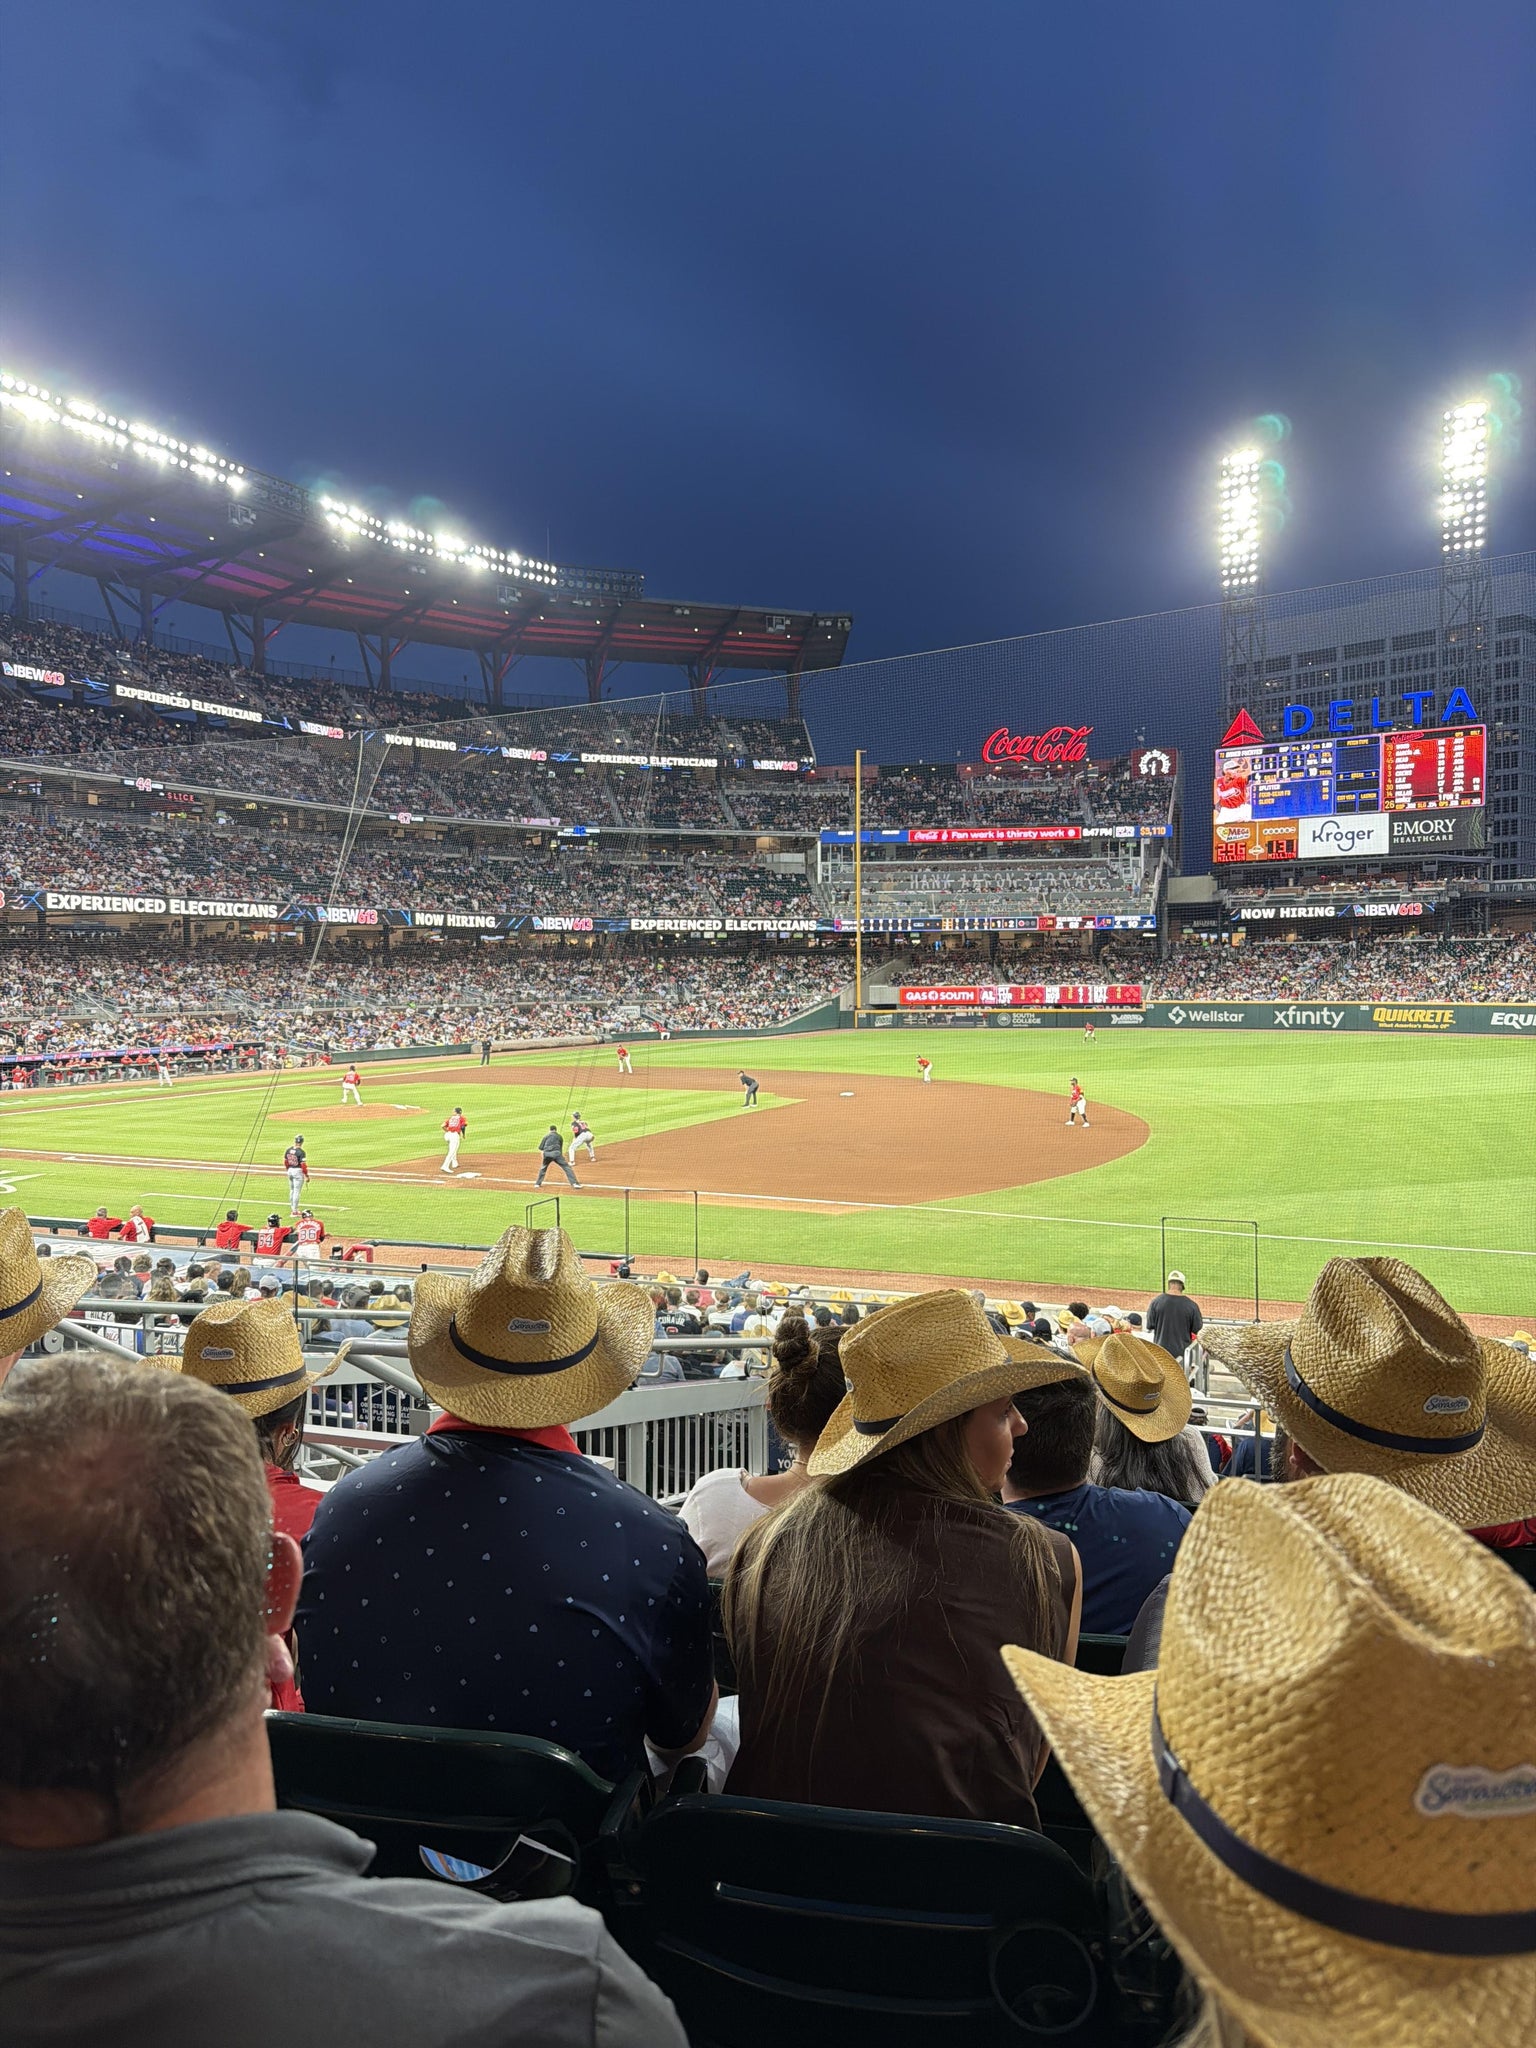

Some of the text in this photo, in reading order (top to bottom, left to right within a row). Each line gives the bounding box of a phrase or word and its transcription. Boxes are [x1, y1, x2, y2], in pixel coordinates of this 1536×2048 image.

[116, 685, 262, 722] EXPERIENCED ELECTRICIANS
[1283, 687, 1478, 737] DELTA
[386, 734, 456, 751] NOW HIRING
[982, 725, 1094, 764] Coca-Cola
[581, 753, 718, 768] EXPERIENCED ELECTRICIANS
[167, 792, 194, 802] SLICE
[951, 831, 968, 839] Fan
[996, 830, 1005, 838] is
[1006, 829, 1037, 840] thirsty
[1039, 829, 1065, 838] work
[1393, 819, 1456, 836] EMORY
[1312, 820, 1374, 851] Kroger
[1393, 834, 1454, 844] HEALTHCARE
[1218, 842, 1246, 855] 296
[1272, 840, 1297, 853] 131
[910, 871, 1111, 890] HANK AARON TERRACE
[46, 893, 278, 918] EXPERIENCED ELECTRICIANS
[1241, 906, 1335, 920] NOW HIRING
[1364, 902, 1423, 917] IBEW613
[415, 912, 496, 928] NOW HIRING
[630, 918, 817, 931] EXPERIENCED ELECTRICIANS
[906, 991, 974, 1000] GAS SOUTH
[981, 990, 995, 1001] AL
[1189, 1010, 1245, 1023] Wellstar
[1274, 1005, 1345, 1028] xfinity
[1373, 1007, 1456, 1024] QUIKRETE
